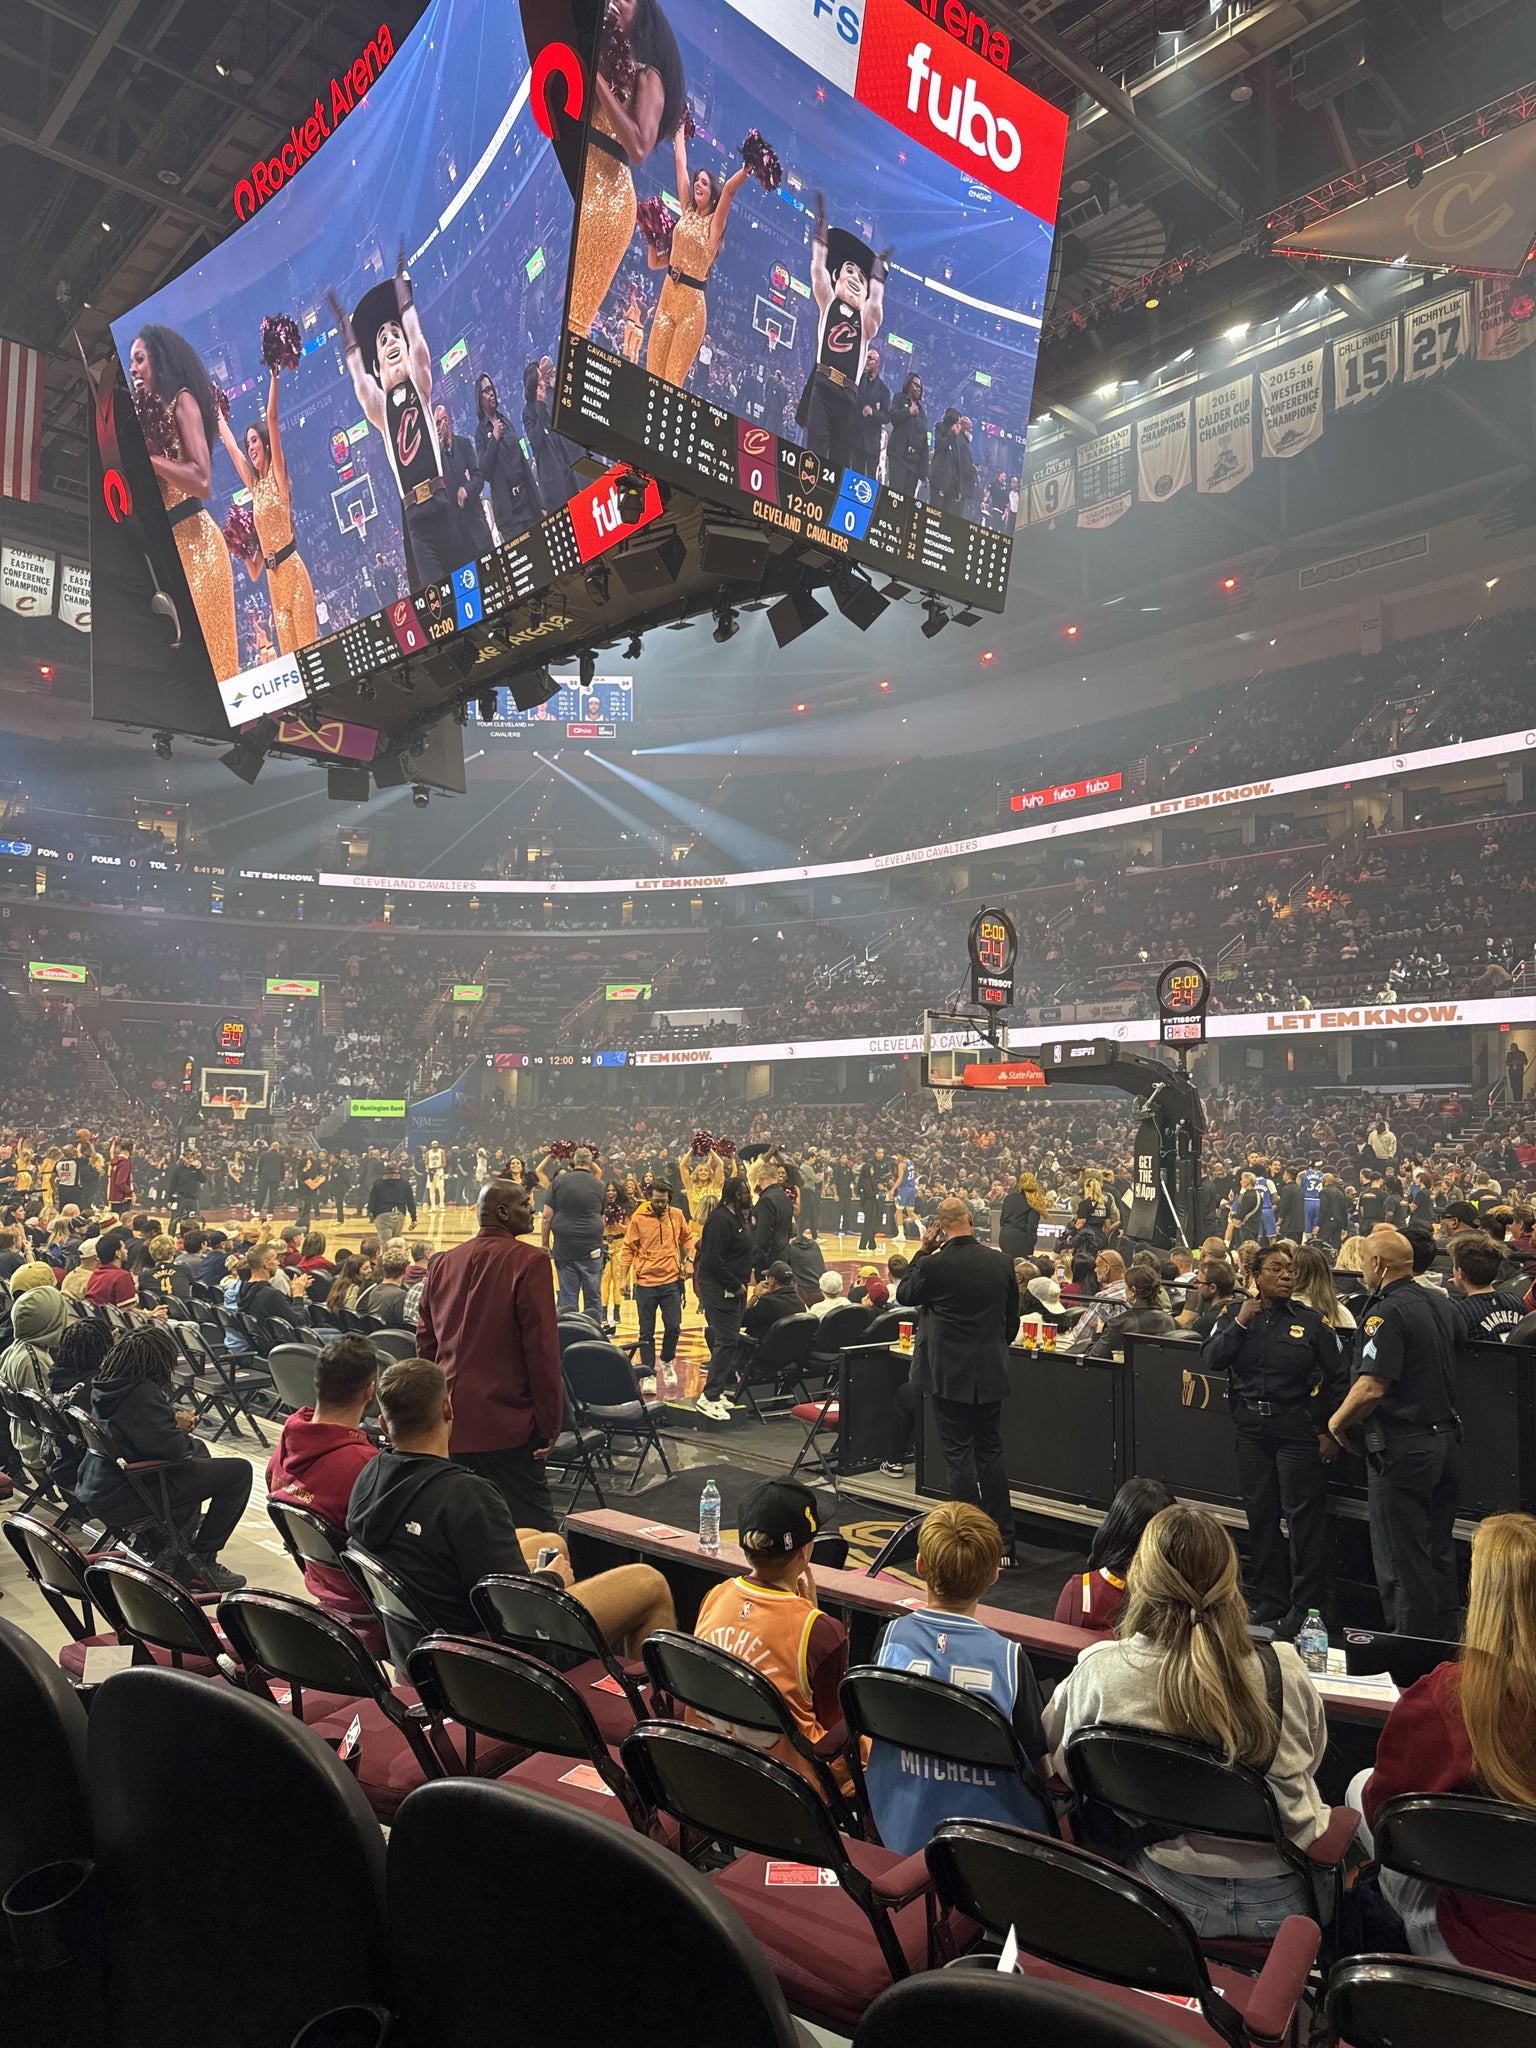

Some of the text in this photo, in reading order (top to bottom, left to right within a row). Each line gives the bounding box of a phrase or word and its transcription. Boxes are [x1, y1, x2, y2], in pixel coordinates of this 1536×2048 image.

[252, 25, 395, 204] Rocket Arena
[906, 42, 1022, 173] fubo
[1339, 327, 1393, 357] CALLANDER
[1413, 316, 1461, 373] 27
[587, 345, 622, 368] CAVALIERS
[586, 358, 612, 376] HARDEN
[1270, 361, 1314, 387] 2015-16
[1345, 345, 1388, 398] 15
[585, 370, 610, 387] MOBLEY
[563, 385, 602, 409] 31 ALLEN
[584, 382, 610, 400] WATSON
[1271, 377, 1313, 402] WESTERN
[1212, 390, 1236, 408] 2016
[1265, 388, 1320, 418] CONFERENCE
[561, 397, 610, 426] 45 MITCHELL
[709, 406, 728, 421] FOULS
[1199, 399, 1250, 429] CALDER CUP
[1266, 402, 1317, 430] CHAMPIONS
[714, 417, 720, 427] 0
[1141, 417, 1186, 445] CHAMPIONS
[1200, 413, 1250, 443] CHAMPIONS
[1078, 429, 1129, 455] CLEVELAND
[722, 449, 727, 457] 0
[781, 450, 796, 467] 1Q
[822, 468, 835, 483] 24
[1033, 459, 1072, 481] GLOVER
[750, 469, 763, 491] 0
[888, 490, 904, 502] FOULS
[892, 500, 898, 509] 0
[1045, 479, 1059, 513] 9
[787, 494, 823, 522] 12:00
[926, 506, 943, 518] MAGIC
[752, 500, 849, 553] CLEVELAND CAVALIERS
[845, 511, 856, 532] 0
[10, 546, 46, 562] 2016-17
[11, 559, 44, 574] EASTERN
[3, 567, 51, 586] CONFERENCE
[5, 578, 48, 595] CHAMPIONS
[440, 584, 451, 597] 24
[415, 598, 426, 610] 1Q
[464, 601, 474, 619] 0
[428, 617, 454, 641] 12:00
[407, 630, 416, 647] 0
[252, 670, 300, 699] CLIFFS
[1053, 788, 1076, 801] fubo
[1085, 780, 1110, 794] fubo
[1150, 783, 1274, 816] LET EM KNOW.
[875, 840, 978, 868] CLEVELAND CAVALIERS
[37, 848, 58, 858] FG%
[67, 852, 74, 862] 0
[91, 855, 121, 865] FOULS
[129, 859, 136, 868] 0
[149, 861, 167, 870] TOL
[174, 863, 181, 872] 7
[212, 867, 225, 876] PM
[240, 870, 260, 879] LET
[262, 872, 277, 880] EM
[278, 872, 315, 882] KNOW.
[353, 877, 476, 890] CLEVELAND CAVALIERS
[636, 877, 728, 889] LET EM KNOW.
[981, 923, 1005, 941] 12:00
[980, 939, 1003, 968] 24
[1171, 975, 1199, 989] 12:00
[1172, 989, 1193, 1007] 24
[1267, 1005, 1463, 1031] LET EM KNOW.
[221, 1032, 242, 1047] 24
[522, 1056, 529, 1066] 0
[549, 1056, 574, 1065] 12:00
[596, 1055, 603, 1065] 0
[650, 1053, 669, 1063] EM
[672, 1051, 712, 1063] KNOW.
[1070, 1047, 1095, 1057] ESPN
[360, 1105, 390, 1113] Huntington
[412, 1116, 432, 1128] NJM
[1138, 1155, 1153, 1169] GET
[1138, 1169, 1153, 1183] THE
[1141, 1183, 1156, 1201] App
[1306, 1181, 1323, 1193] 34
[160, 1276, 173, 1295] 4
[901, 1749, 996, 1787] MITCHELL
